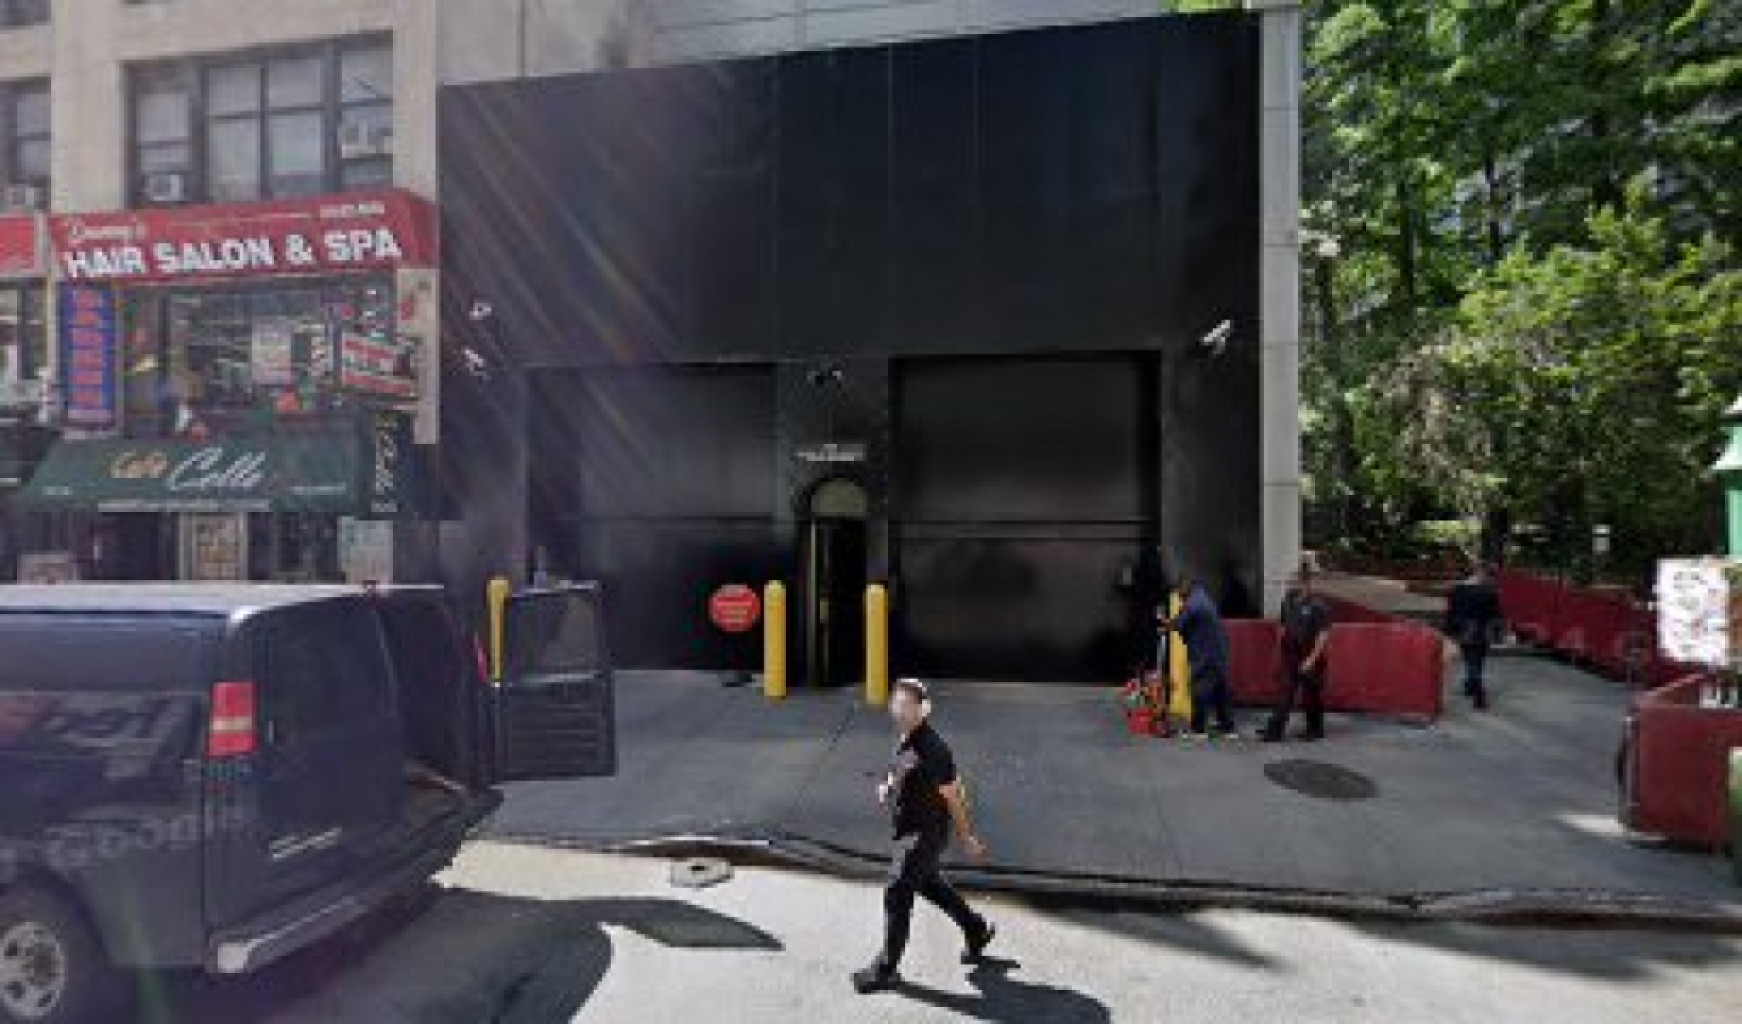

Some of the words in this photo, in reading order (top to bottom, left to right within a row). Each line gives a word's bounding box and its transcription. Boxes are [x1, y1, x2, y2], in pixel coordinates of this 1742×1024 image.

[65, 242, 146, 278] HAIR
[152, 237, 275, 273] SALON
[285, 234, 313, 264] &
[324, 226, 402, 262] SPA
